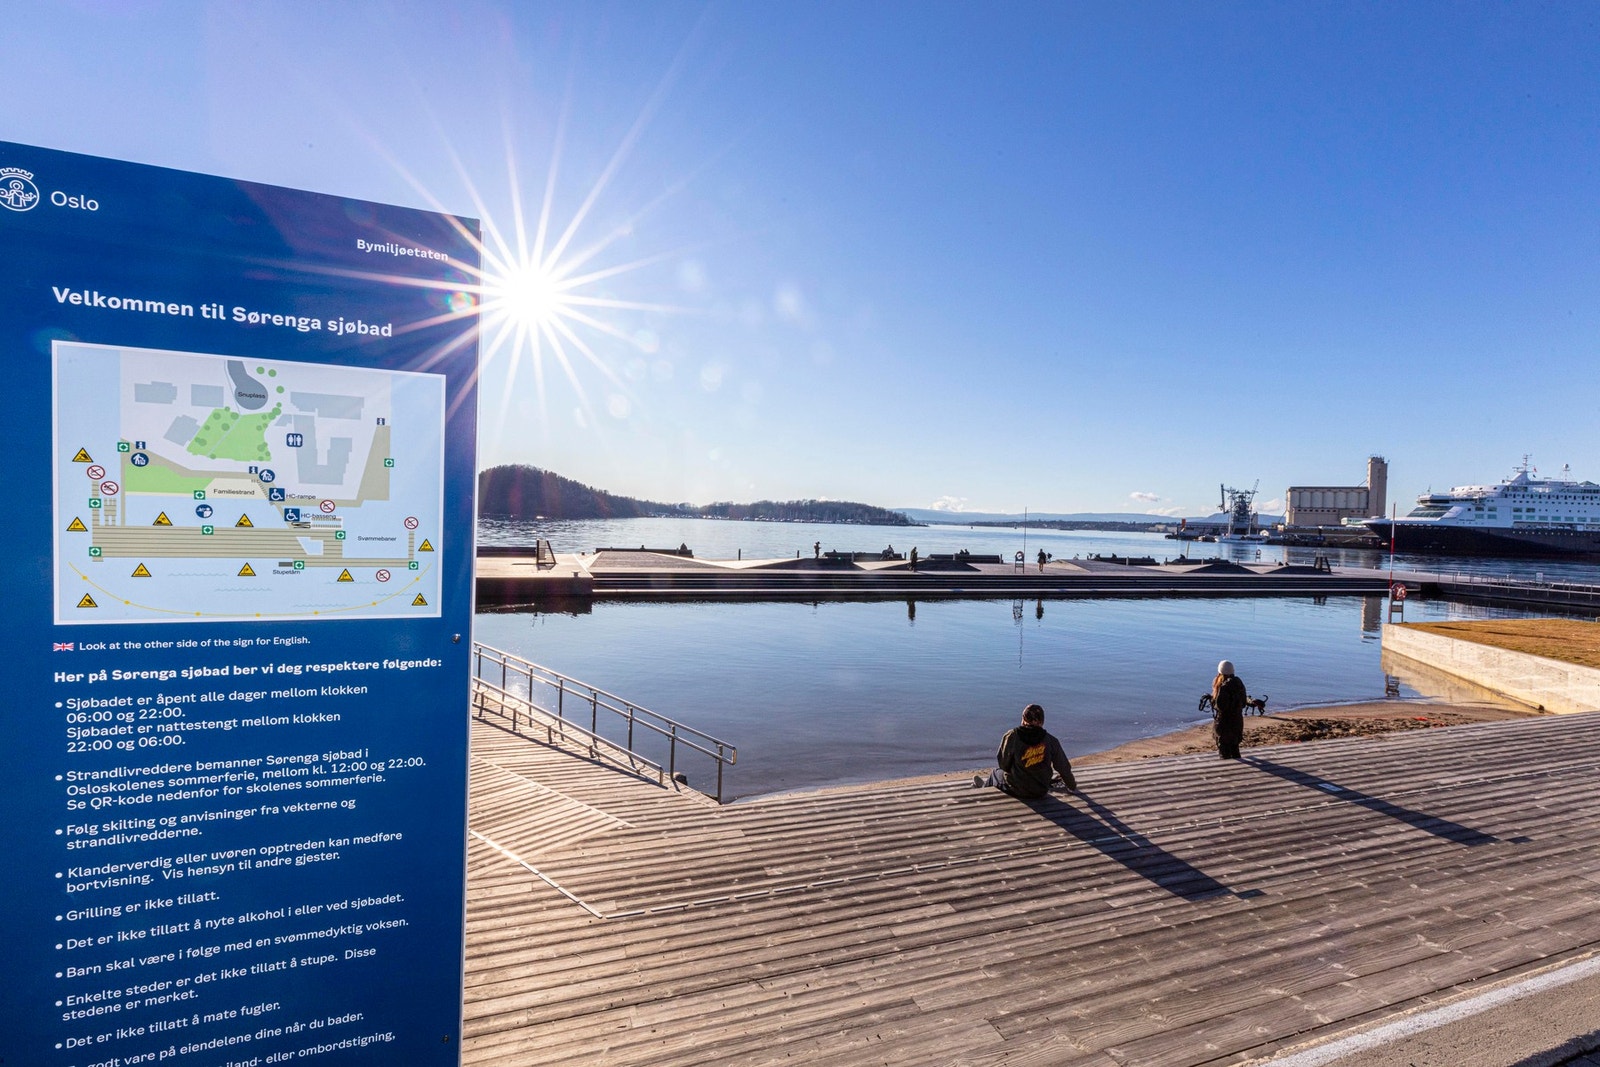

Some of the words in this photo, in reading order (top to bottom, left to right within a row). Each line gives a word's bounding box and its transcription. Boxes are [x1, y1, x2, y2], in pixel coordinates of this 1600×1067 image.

[50, 191, 99, 211] Oslo
[357, 239, 448, 261] Bymiljøetaten
[52, 286, 194, 317] Velkommen
[200, 303, 226, 320] til
[232, 306, 321, 332] Sørenga
[327, 317, 392, 337] sjøbad
[79, 642, 106, 651] Look
[109, 642, 121, 650] at
[123, 641, 142, 650] the
[144, 640, 174, 649] other
[176, 639, 198, 648] side
[200, 638, 211, 647] of
[213, 638, 231, 647] the
[233, 638, 254, 648] sign
[256, 637, 271, 645] for
[273, 636, 311, 646] English.
[54, 672, 84, 682] Her
[88, 669, 107, 684] på
[112, 669, 177, 681] Sørenga
[181, 666, 229, 680] sjøbad
[233, 666, 258, 676] ber
[261, 663, 273, 674] vi
[277, 664, 302, 675] deg
[306, 661, 380, 673] respektere
[382, 658, 442, 670] følgende:
[66, 696, 133, 711] Sjøbadet
[137, 697, 153, 706] er
[156, 693, 197, 706] åpent
[200, 691, 225, 702] alle
[228, 690, 267, 702] dager
[271, 687, 317, 698] mellom
[321, 685, 368, 696] klokken
[66, 711, 113, 724] 06:00
[116, 712, 135, 723] og
[139, 707, 186, 719] 22:00.
[66, 725, 133, 740] Sjøbadet
[137, 725, 153, 734] er
[157, 718, 238, 732] nattestengt
[242, 715, 289, 727] mellom
[293, 712, 341, 724] klokken
[67, 739, 113, 753] 22:00
[116, 740, 135, 751] og
[138, 734, 186, 748] 06:00.
[66, 763, 192, 782] Strandlivreddere
[196, 758, 263, 771] bemanner
[266, 754, 319, 765] Sørenga
[322, 749, 362, 763] sjøbad
[365, 748, 369, 758] i
[66, 780, 165, 796] Osloskolenes
[168, 770, 259, 787] sommerferie,
[262, 767, 309, 779] mellom
[312, 764, 327, 775] kl.
[331, 761, 368, 773] 12:00
[370, 762, 385, 772] og
[388, 757, 426, 769] 22:00.
[67, 799, 86, 810] Se
[90, 793, 153, 810] QR-kode
[157, 787, 219, 802] nedenfor
[222, 785, 243, 795] for
[246, 781, 302, 794] skolenes
[305, 773, 386, 788] sommerferie.
[66, 823, 99, 836] Følg
[102, 818, 156, 832] skilting
[159, 816, 177, 827] og
[180, 808, 257, 823] anvisninger
[260, 805, 279, 815] fra
[282, 801, 338, 813] vekterne
[340, 799, 356, 810] og
[66, 827, 202, 850] strandlivredderne.
[68, 856, 172, 878] Klanderverdig
[175, 853, 208, 865] eller
[211, 848, 256, 860] uvøren
[259, 840, 325, 856] opptreden
[328, 838, 350, 847] kan
[353, 832, 402, 845] medføre
[66, 874, 154, 893] bortvisning.
[162, 868, 184, 880] Vis
[187, 863, 235, 877] hensyn
[238, 859, 252, 870] til
[255, 856, 292, 868] andre
[295, 852, 340, 866] gjester.
[66, 906, 122, 921] Grilling
[125, 903, 141, 913] er
[145, 898, 173, 910] ikke
[177, 891, 220, 905] tillatt.
[67, 937, 93, 950] Det
[97, 935, 113, 945] er
[117, 930, 146, 942] ikke
[150, 922, 190, 937] tillatt
[193, 919, 201, 930] å
[205, 917, 235, 930] nyte
[238, 908, 285, 923] alkohol
[288, 907, 291, 917] i
[294, 905, 323, 916] eller
[326, 900, 348, 911] ved
[351, 894, 404, 910] sjøbadet.
[66, 965, 102, 978] Barn
[106, 957, 135, 971] skal
[139, 953, 175, 966] være
[179, 949, 182, 960] i
[186, 946, 221, 958] følge
[224, 938, 252, 952] med
[255, 938, 271, 947] en
[274, 924, 363, 944] svømmedyktig
[365, 919, 409, 931] voksen.
[66, 990, 122, 1006] Enkelte
[126, 981, 172, 996] steder
[176, 978, 191, 987] er
[194, 972, 217, 984] det
[221, 968, 247, 979] ikke
[250, 960, 287, 974] tillatt
[290, 957, 297, 968] å
[300, 954, 338, 966] stupe.
[345, 948, 376, 960] Disse
[62, 1003, 122, 1021] stedene
[125, 1000, 141, 1010] er
[145, 989, 198, 1006] merket.
[66, 1035, 93, 1049] Det
[96, 1033, 112, 1043] er
[116, 1027, 145, 1039] ikke
[148, 1018, 188, 1033] tillatt
[192, 1014, 199, 1025] å
[203, 1010, 237, 1023] mate
[240, 1002, 281, 1016] fugler.
[124, 1052, 156, 1065] vare
[159, 1045, 176, 1061] på
[180, 1034, 252, 1054] eiendelene
[255, 1028, 282, 1040] dine
[285, 1022, 306, 1034] når
[309, 1019, 324, 1029] du
[327, 1013, 364, 1026] bader.
[266, 1051, 295, 1064] eller
[298, 1032, 395, 1057] ombordstigning,
